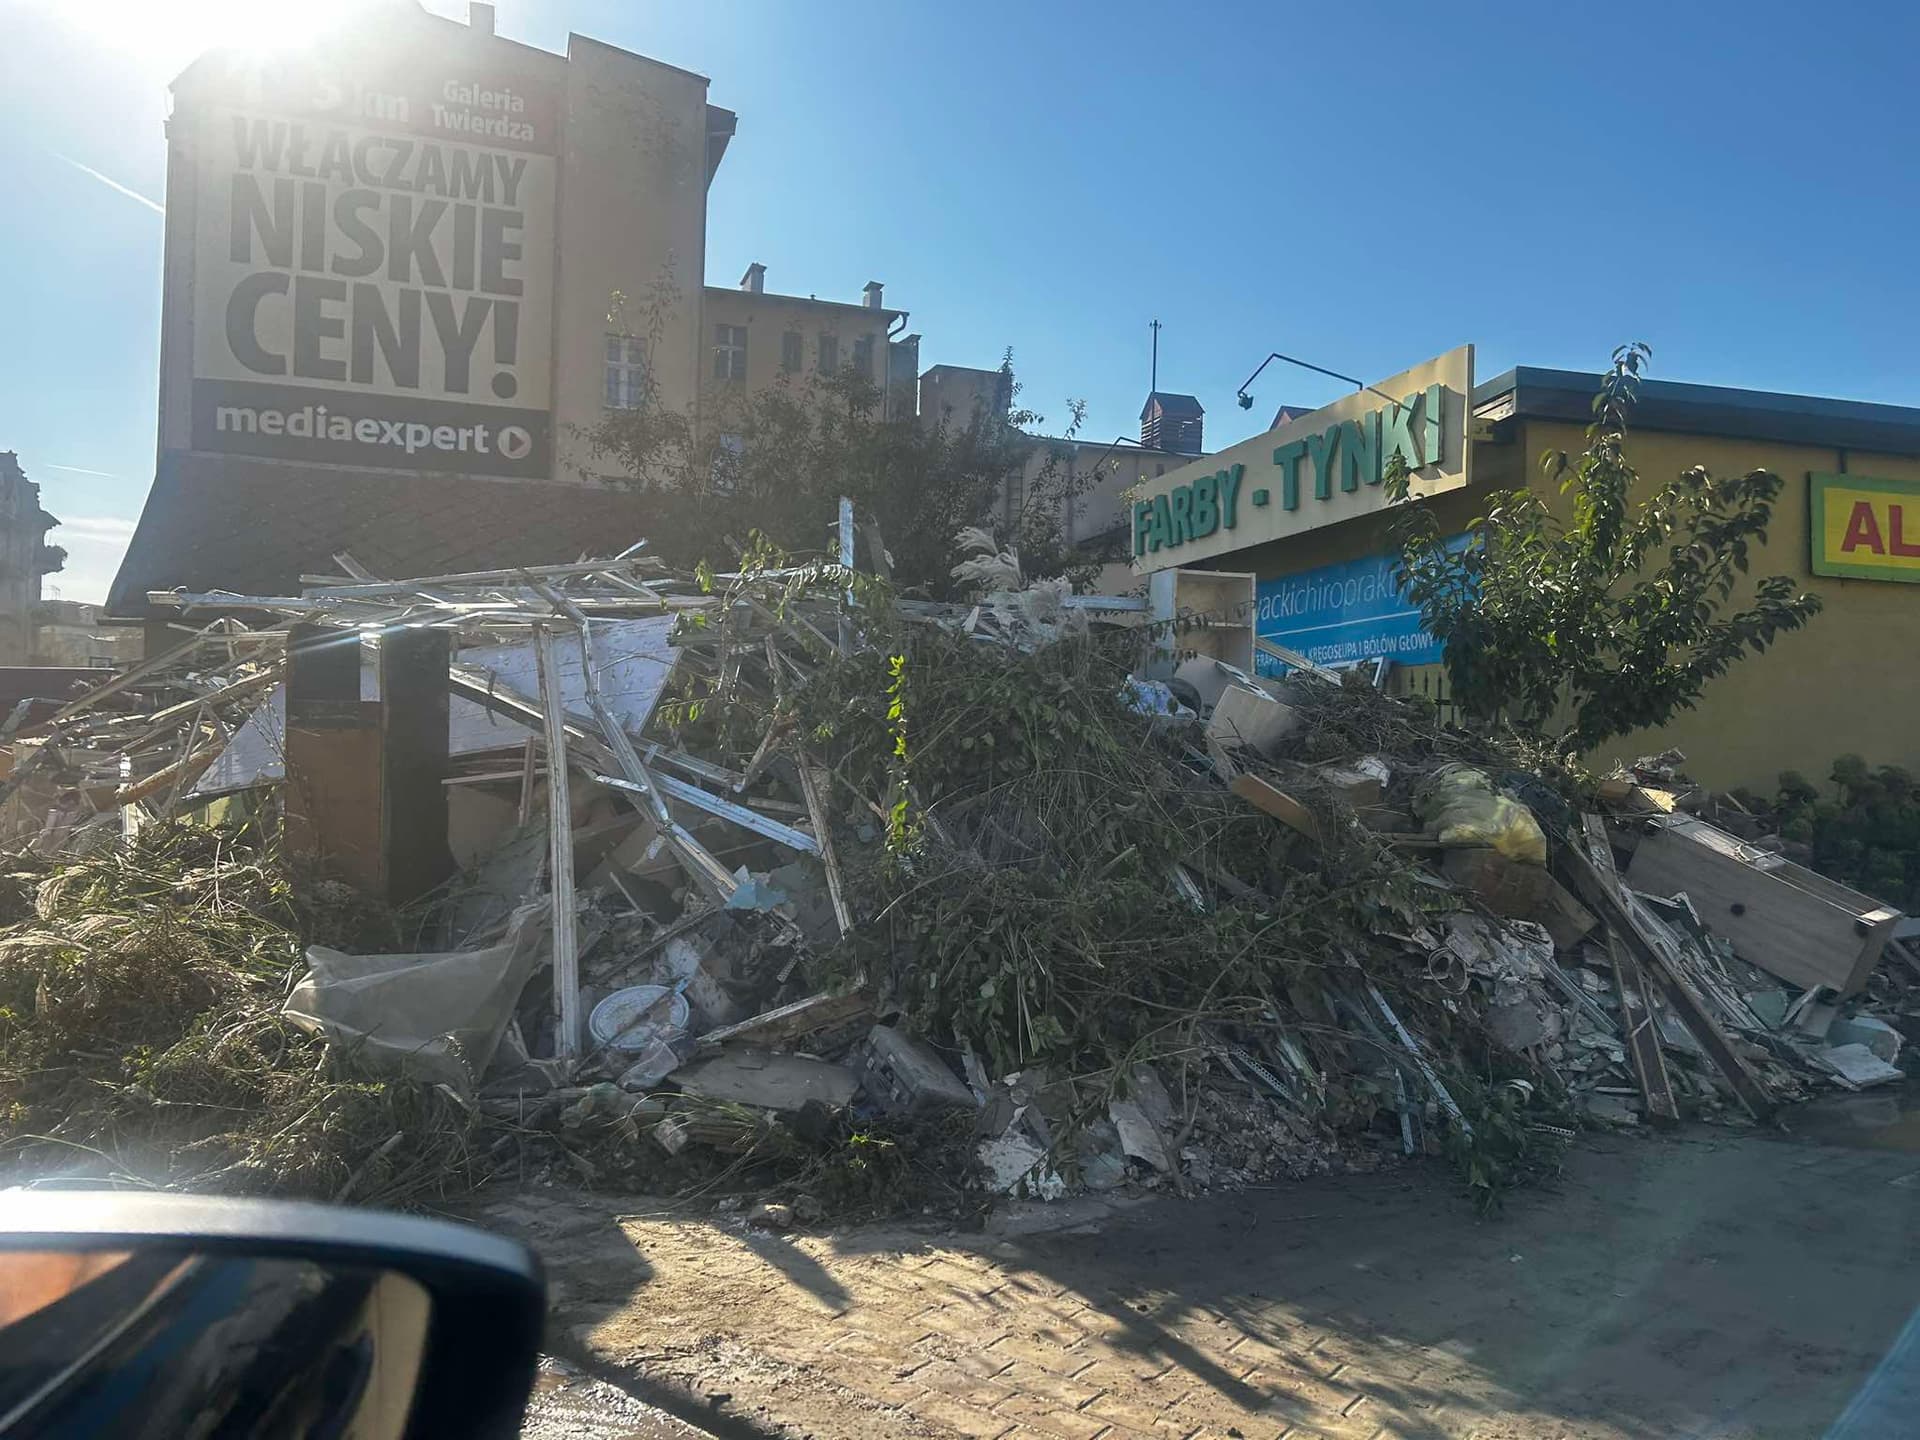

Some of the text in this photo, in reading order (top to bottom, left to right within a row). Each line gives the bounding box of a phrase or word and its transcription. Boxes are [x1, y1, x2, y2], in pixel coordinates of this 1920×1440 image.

[432, 103, 534, 141] Twierdza
[443, 80, 524, 112] Galeria
[234, 117, 527, 206] WŁĄCZAMY
[230, 173, 524, 297] NISKIE
[225, 271, 520, 399] CENY!
[216, 405, 490, 454] mediaexpert
[1133, 463, 1245, 556] FARBY
[1273, 383, 1448, 512] TYNKI
[1364, 632, 1397, 655] BÓLÓW
[1400, 631, 1434, 651] GŁOWY
